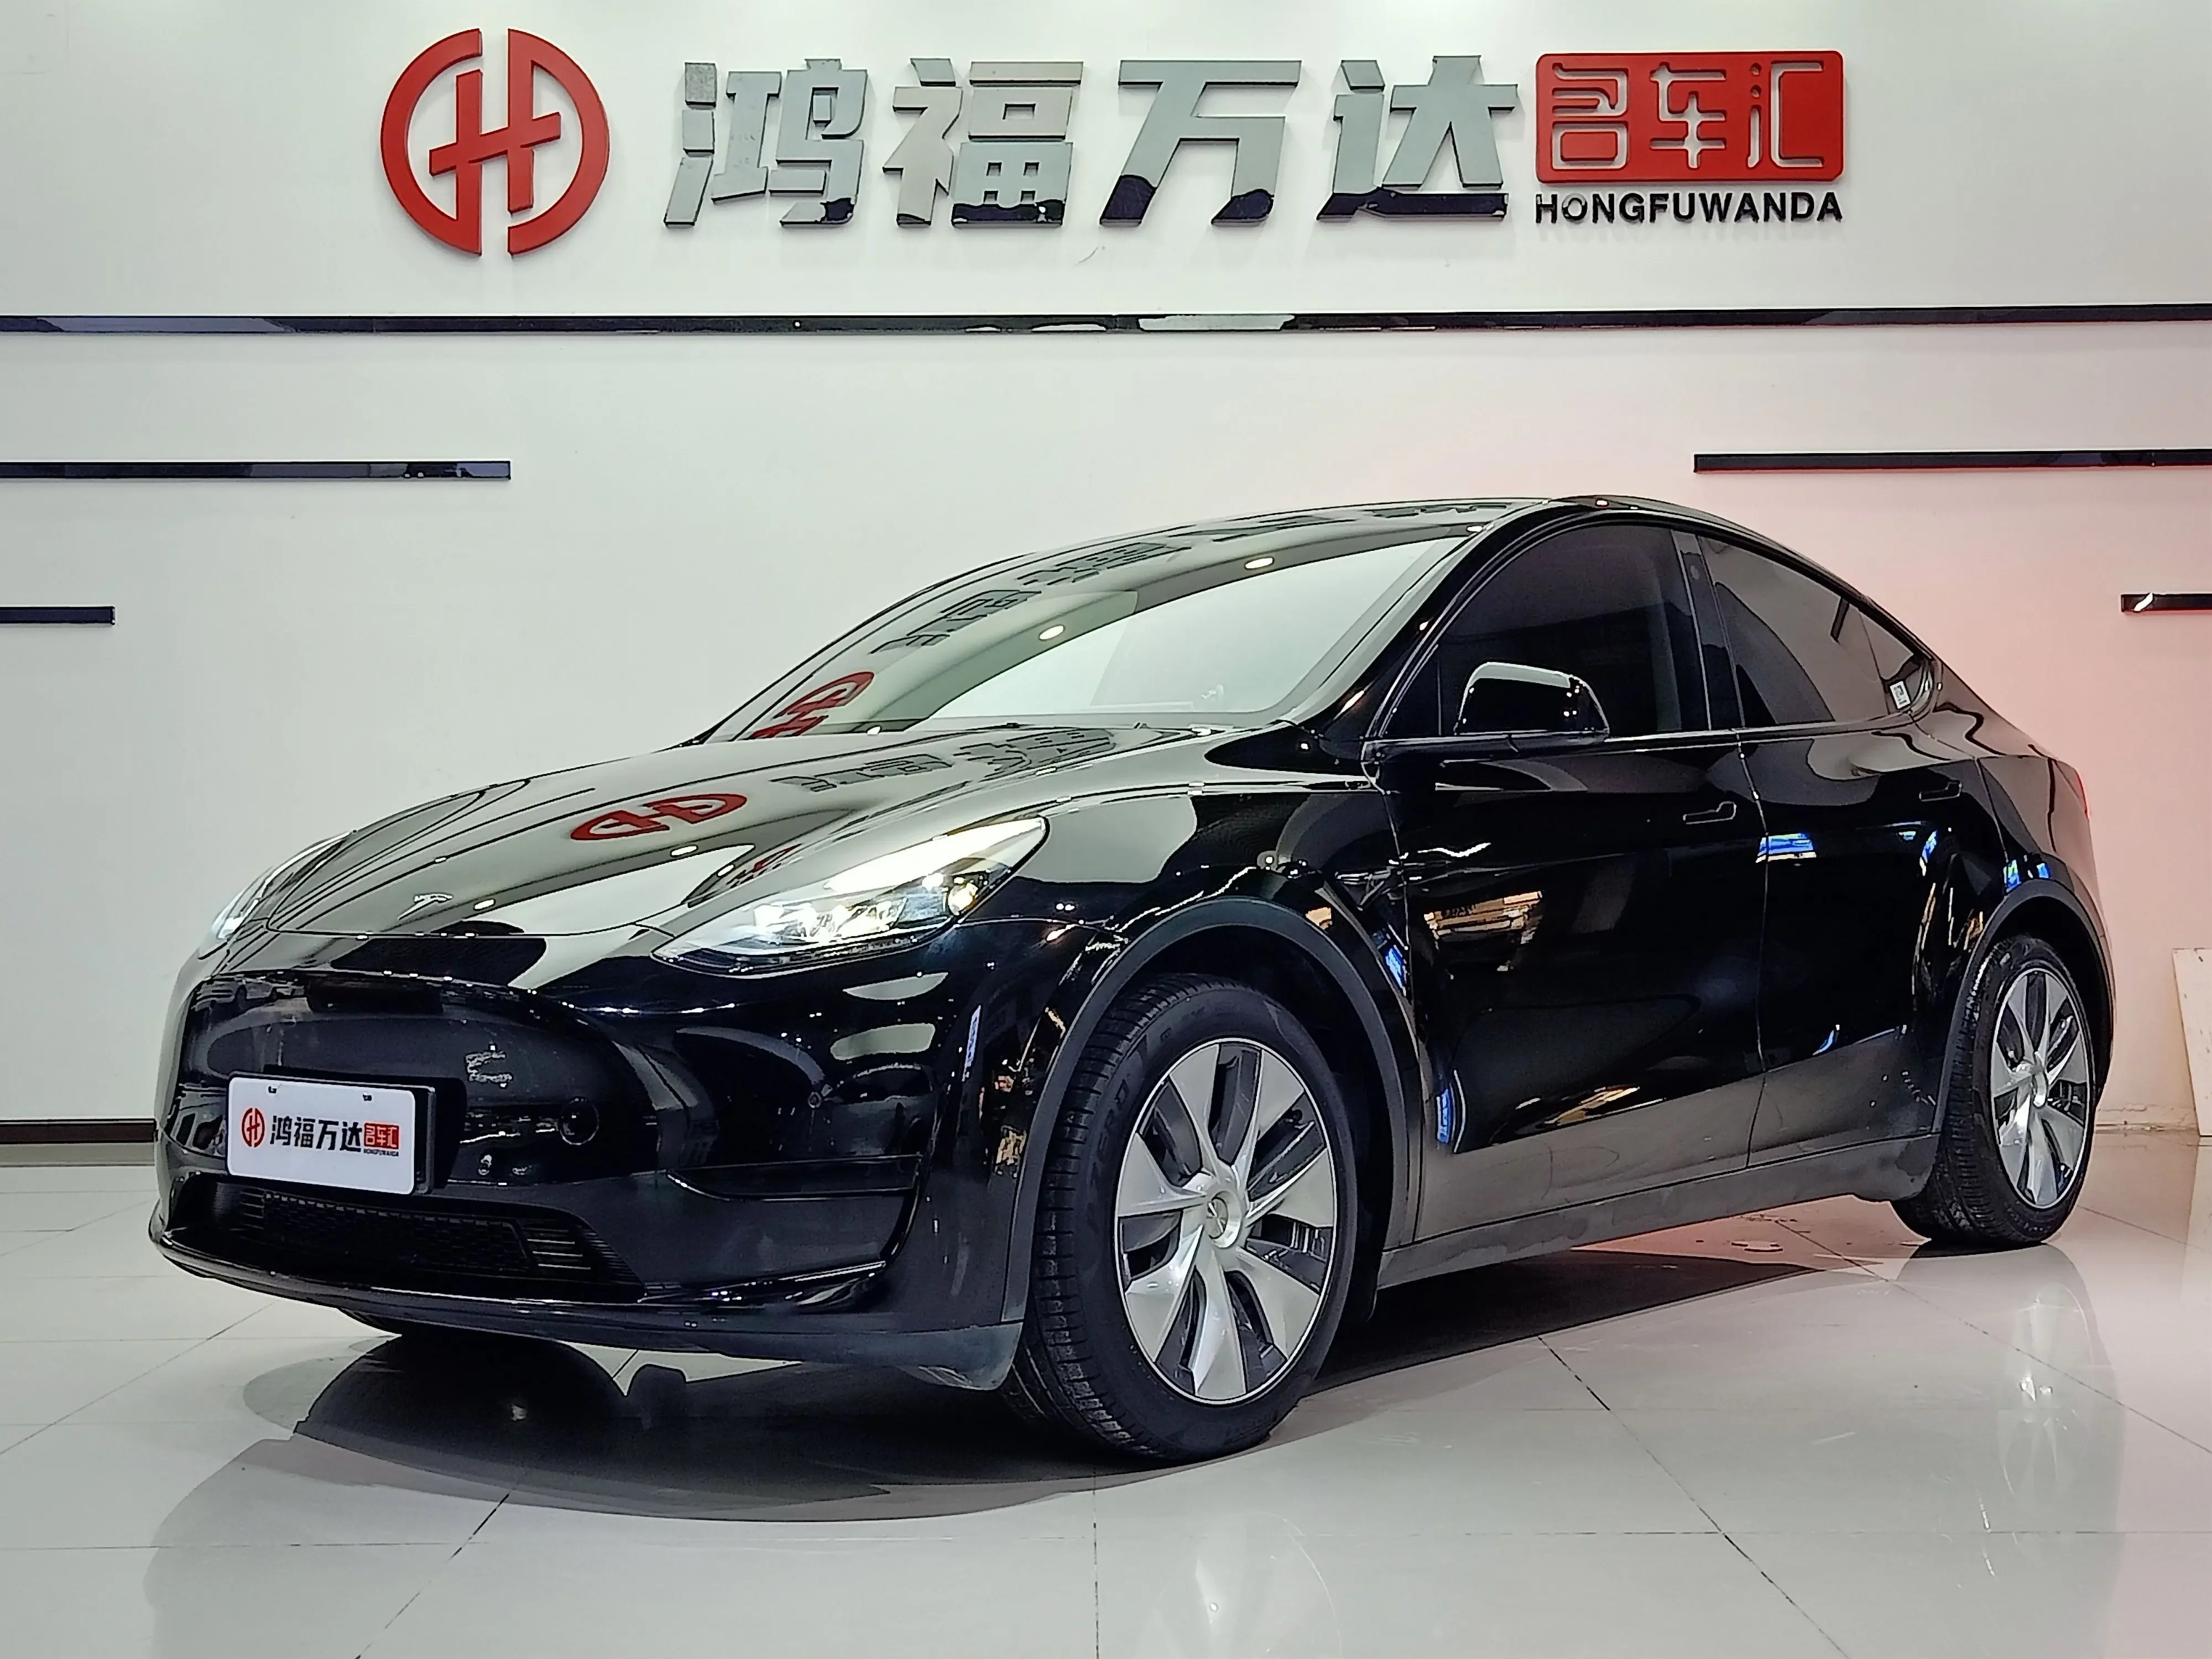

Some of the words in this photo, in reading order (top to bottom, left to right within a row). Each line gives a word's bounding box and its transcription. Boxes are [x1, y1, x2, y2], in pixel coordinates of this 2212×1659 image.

[665, 55, 1519, 228] 鸿福万达
[1551, 61, 1824, 170] 名车汇
[1535, 192, 1844, 224] HONGFUWANDA
[270, 1115, 362, 1152] 鸿福万达
